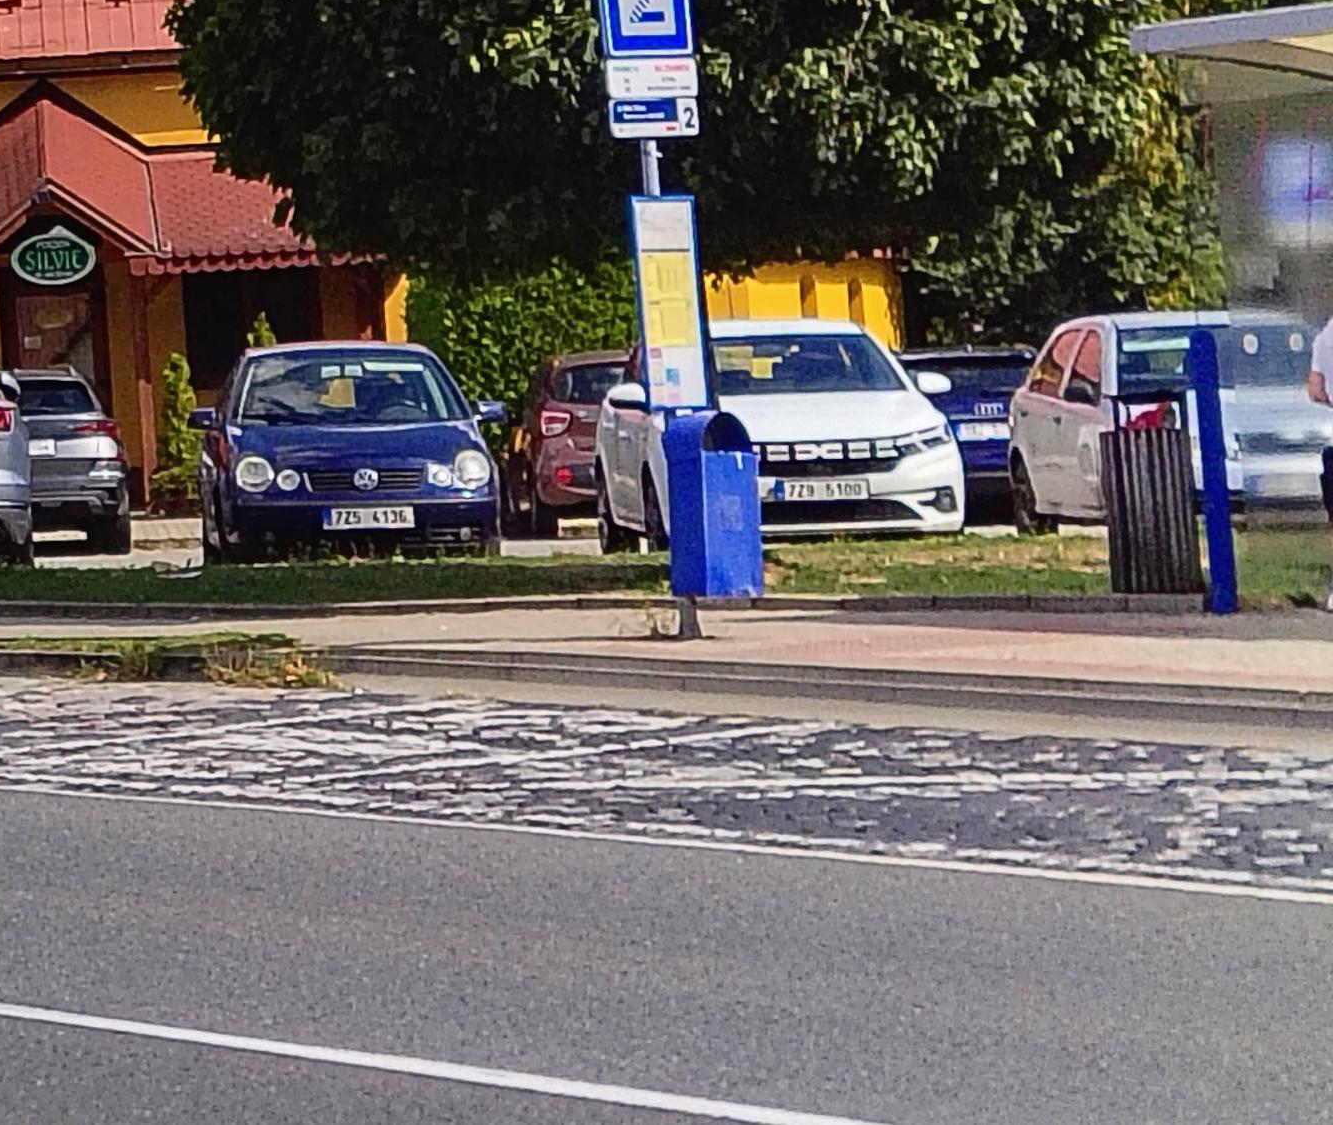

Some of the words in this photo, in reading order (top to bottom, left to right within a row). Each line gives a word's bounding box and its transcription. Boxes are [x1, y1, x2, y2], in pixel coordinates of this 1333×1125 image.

[683, 106, 696, 129] 2
[24, 249, 83, 272] SILVIE
[335, 511, 361, 526] 7Z5
